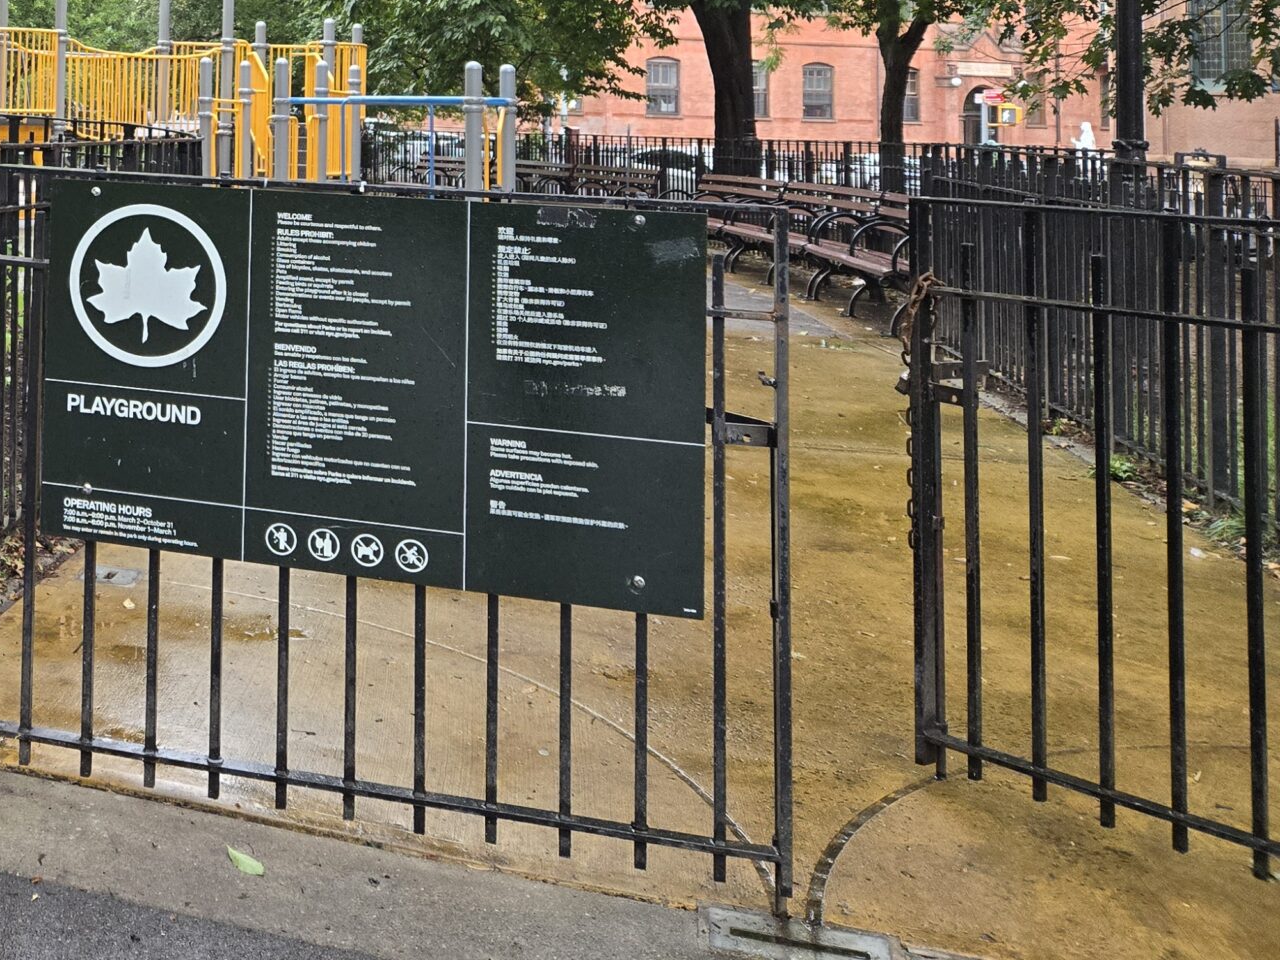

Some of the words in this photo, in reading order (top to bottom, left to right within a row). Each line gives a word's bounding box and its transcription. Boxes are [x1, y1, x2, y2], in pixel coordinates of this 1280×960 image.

[277, 212, 312, 220] WELCOME
[276, 228, 299, 236] RULES
[300, 230, 333, 238] PROHIBIT:
[274, 343, 316, 352] BIENVENIDO
[273, 359, 287, 367] LAS
[288, 361, 316, 369] REGLAS
[66, 393, 202, 426] PLAYGROUND
[490, 438, 526, 448] WARNING
[490, 469, 542, 481] ADVERTENCIA
[63, 497, 116, 512] OPERATING
[117, 504, 152, 517] HOURS
[104, 514, 116, 522] p.m.
[117, 515, 135, 523] March
[104, 521, 116, 529] p.m.
[117, 522, 146, 531] November
